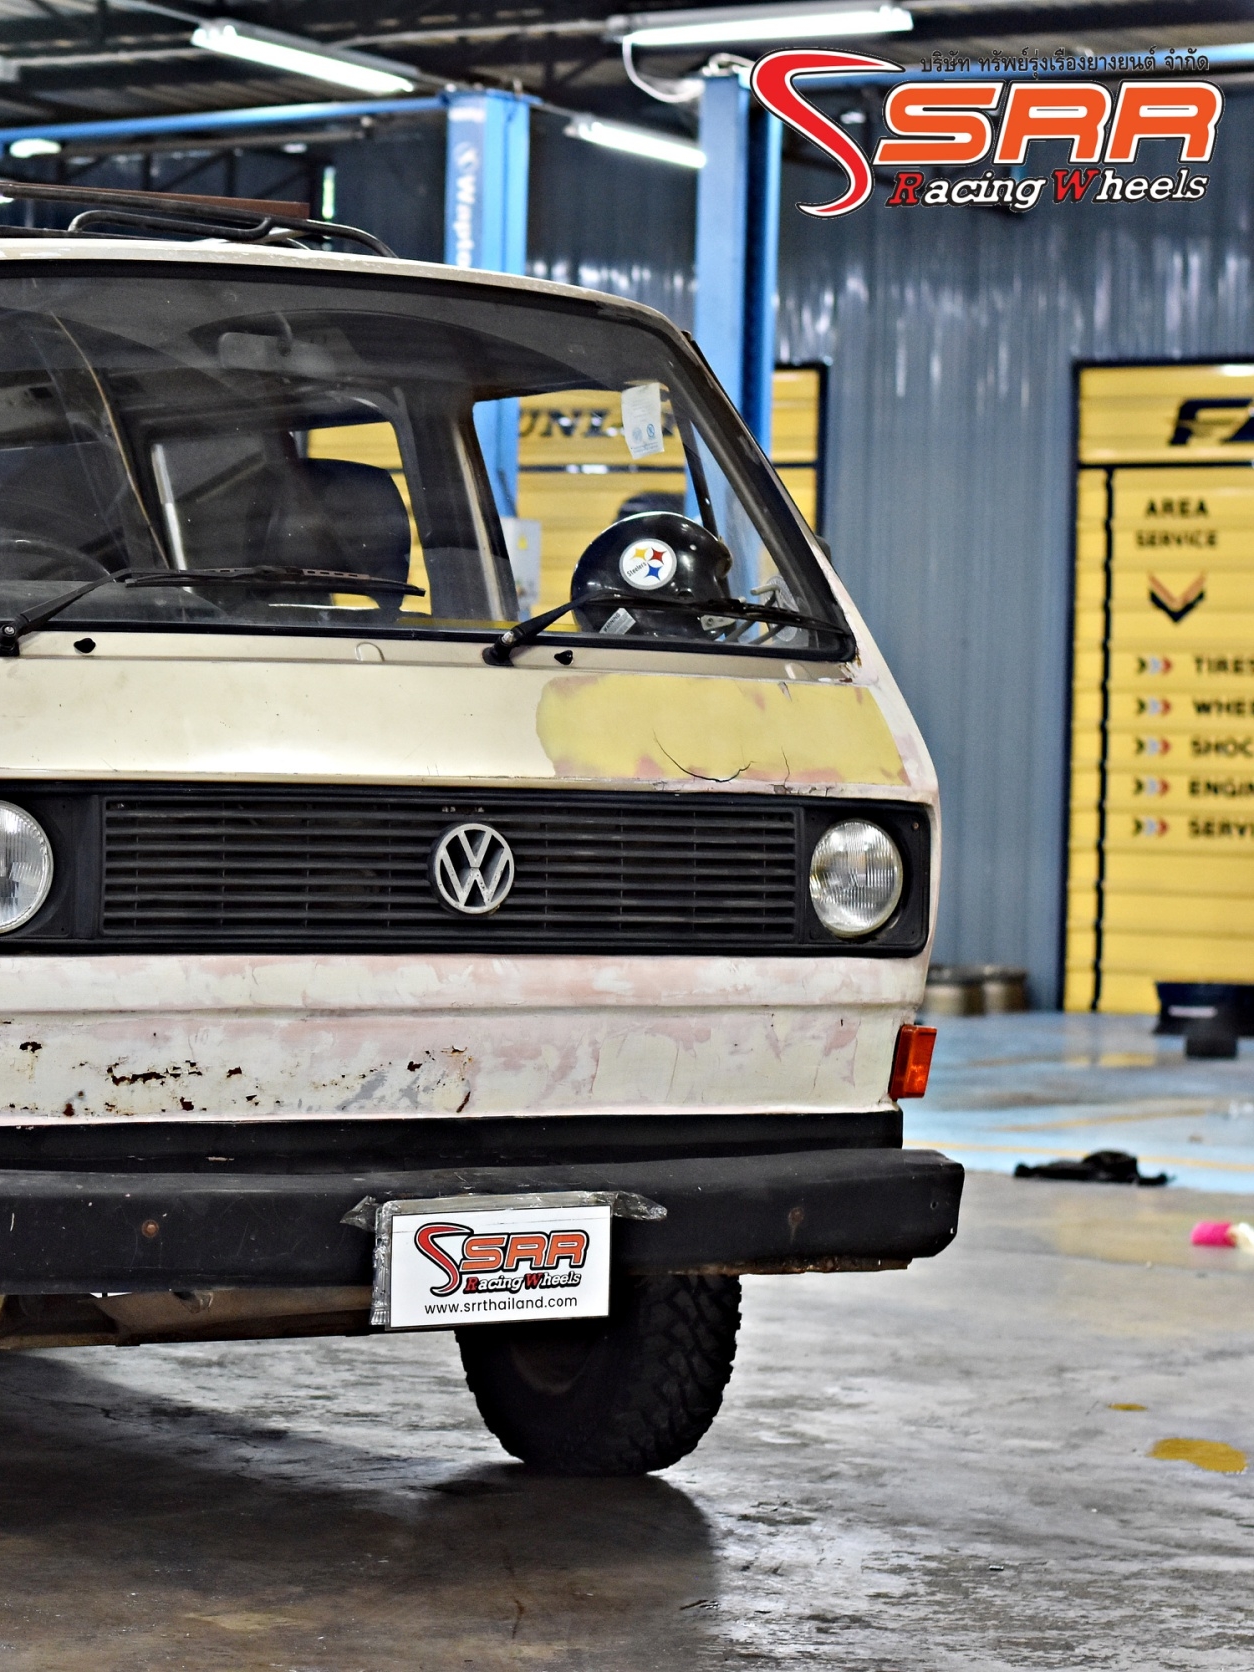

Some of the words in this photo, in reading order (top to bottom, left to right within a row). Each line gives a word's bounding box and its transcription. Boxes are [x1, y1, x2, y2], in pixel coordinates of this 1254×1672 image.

[1146, 499, 1209, 518] AREA
[1136, 530, 1218, 547] SERVICE
[626, 562, 647, 577] Steelers
[435, 823, 515, 914] VW
[460, 1231, 588, 1271] SRR
[465, 1277, 524, 1292] Racing
[524, 1272, 581, 1290] Wheels
[424, 1296, 578, 1315] www.srrthailand.com
